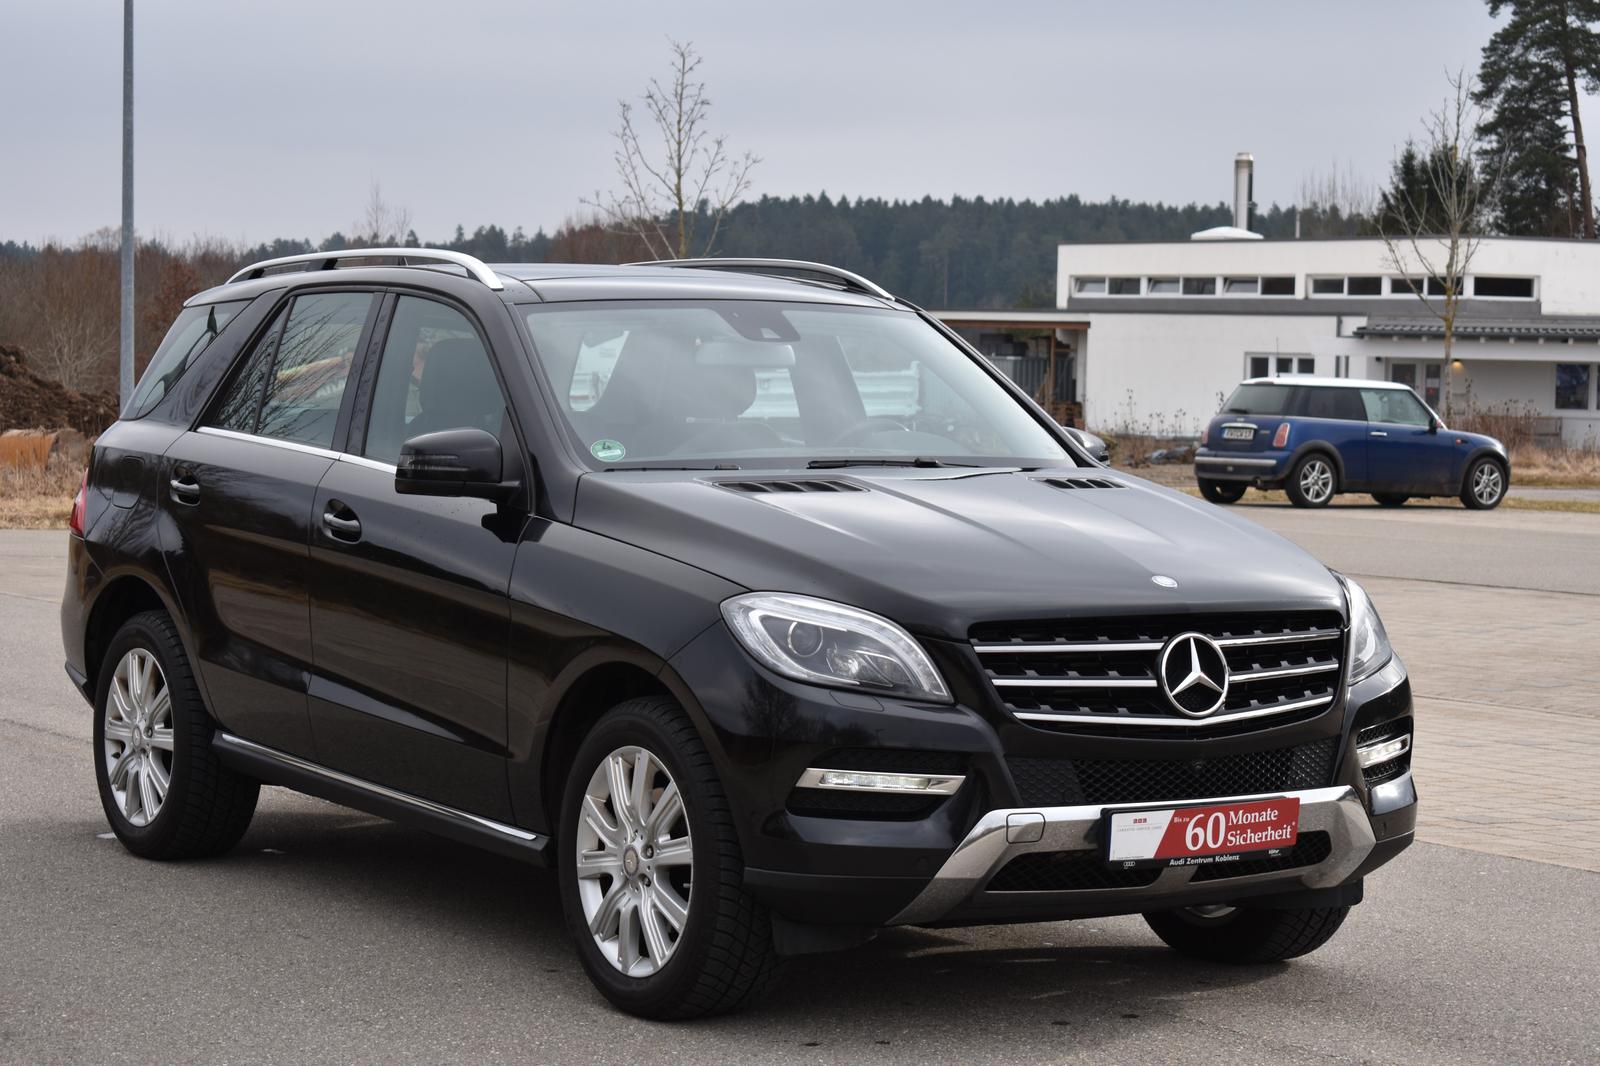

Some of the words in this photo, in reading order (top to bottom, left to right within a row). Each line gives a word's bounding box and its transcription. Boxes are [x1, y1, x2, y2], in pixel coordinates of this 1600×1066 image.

[1228, 808, 1278, 825] Monate
[1185, 812, 1226, 851] 60
[1169, 858, 1185, 866] Audi
[1186, 857, 1213, 865] Zentrum
[1215, 854, 1240, 863] Koblenz
